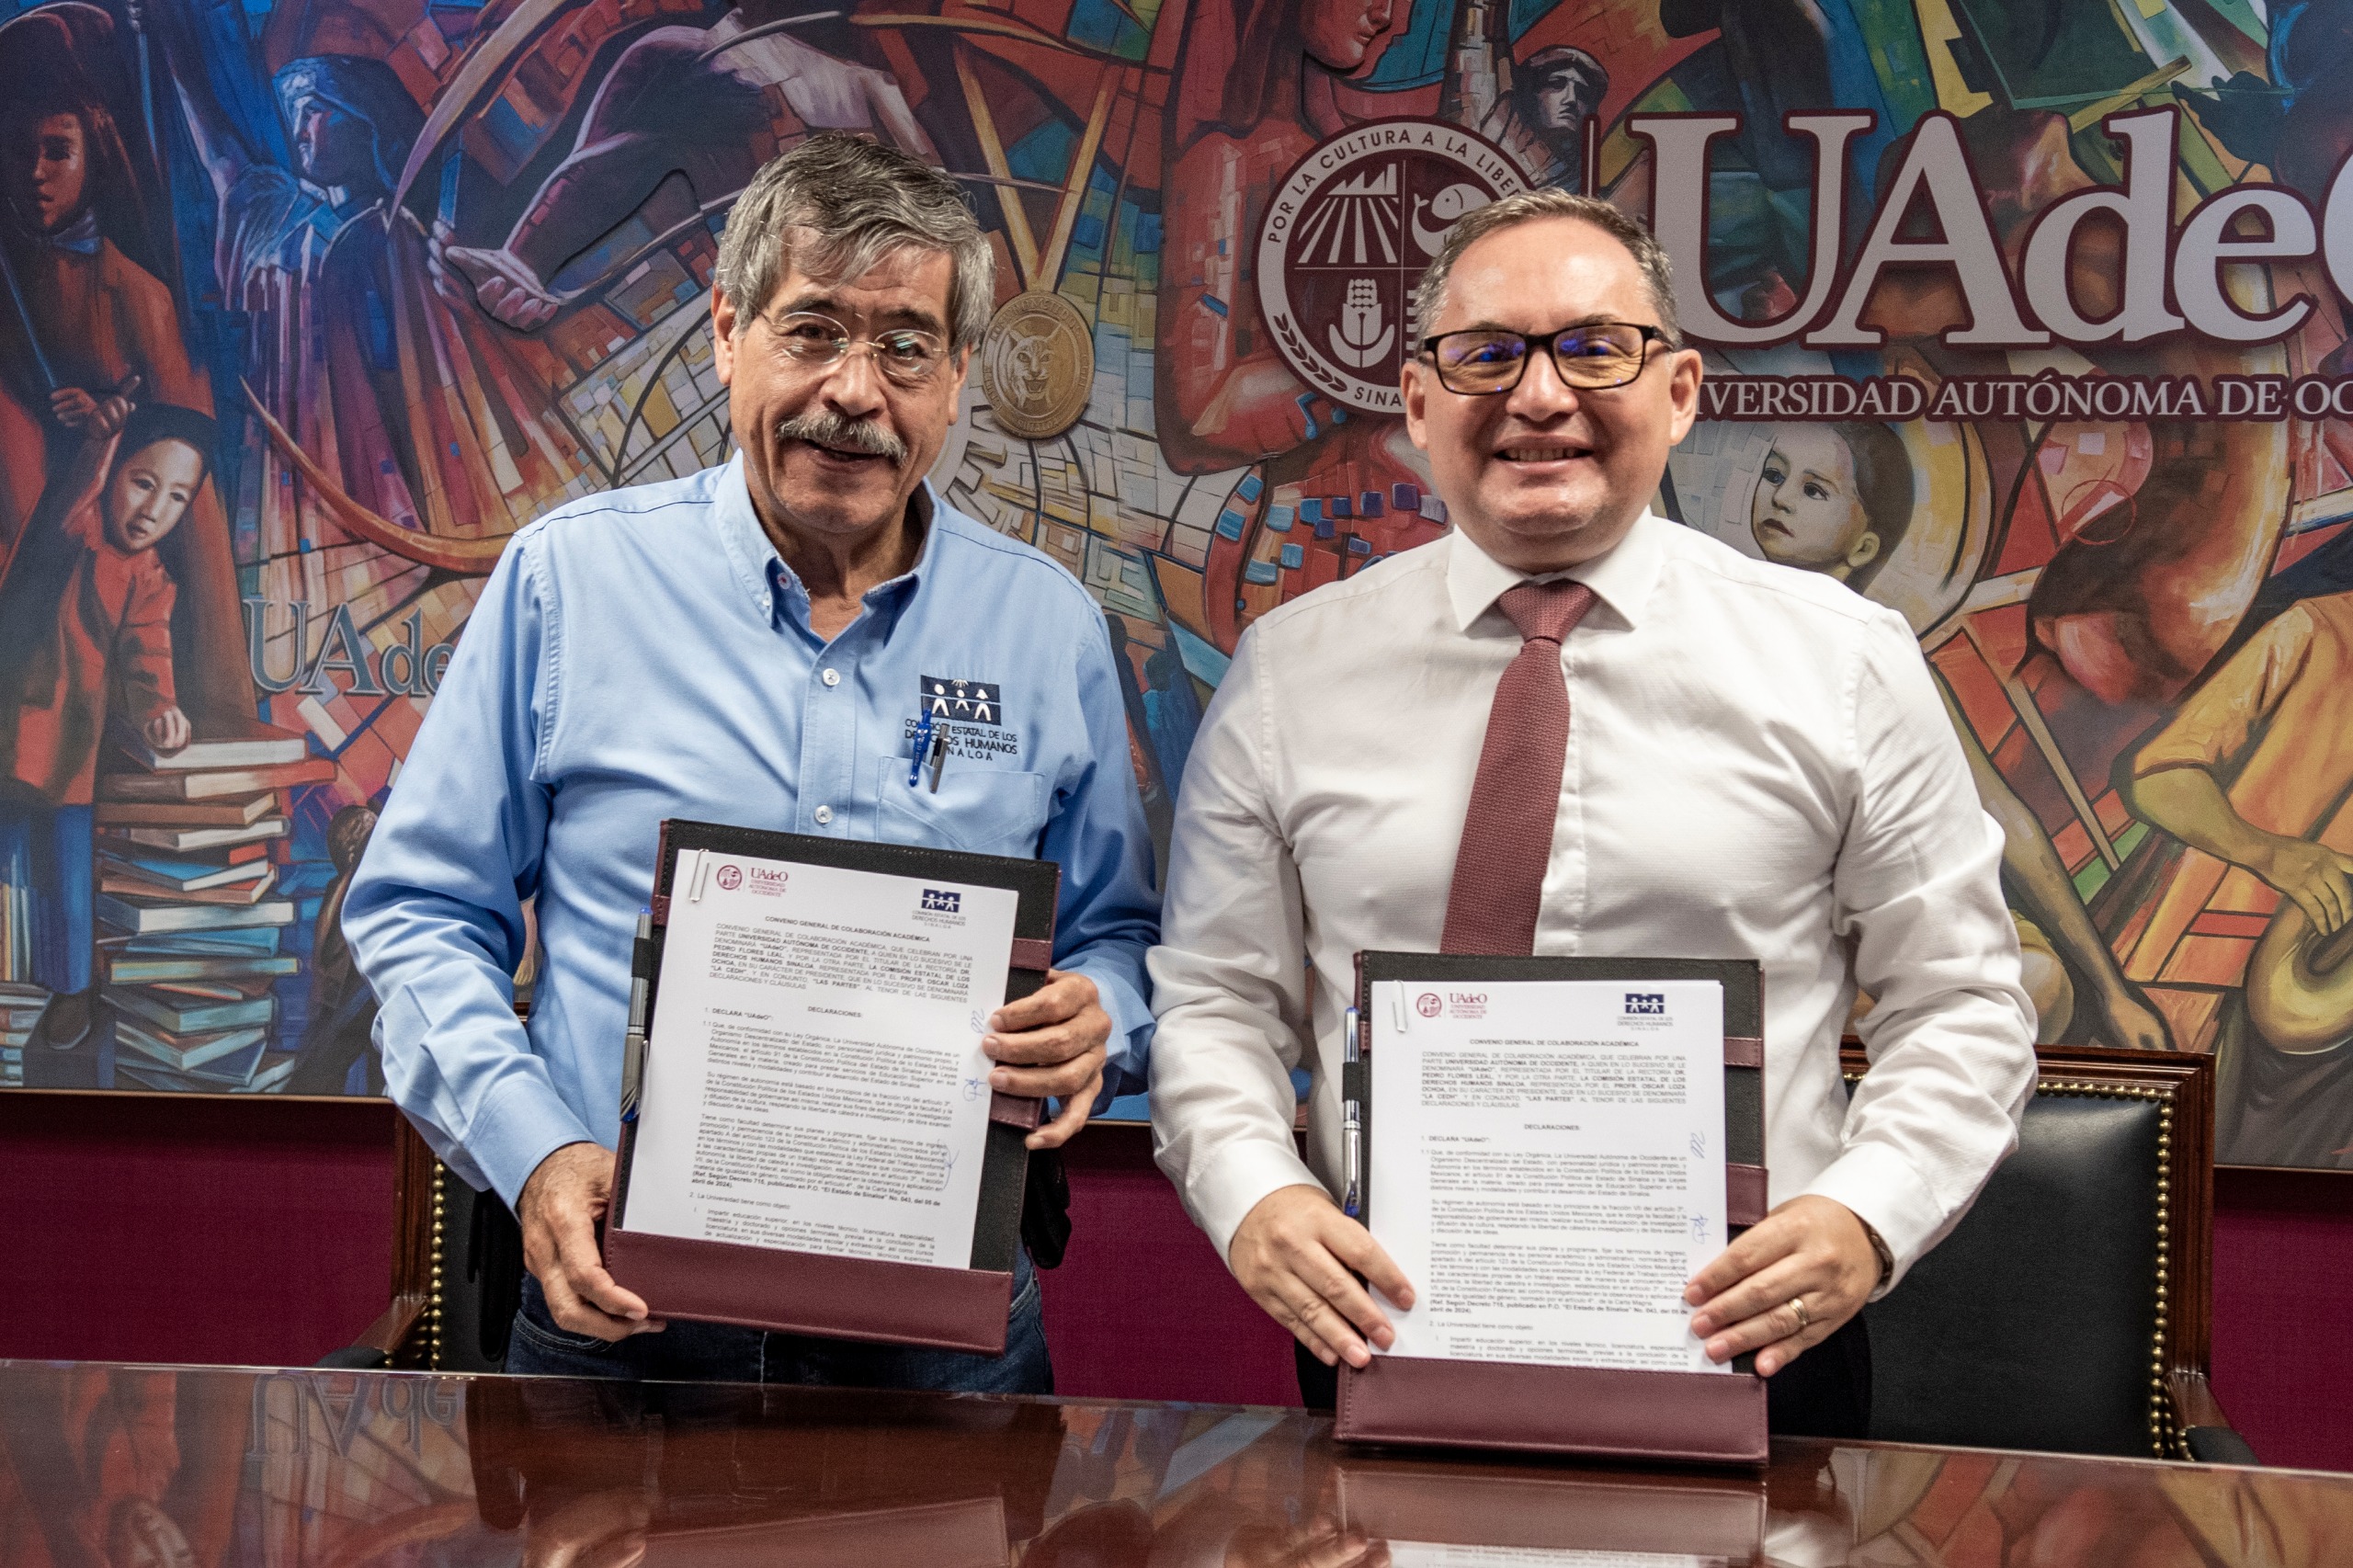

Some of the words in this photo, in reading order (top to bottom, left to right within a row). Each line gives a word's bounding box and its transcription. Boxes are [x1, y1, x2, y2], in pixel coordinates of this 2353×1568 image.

[1267, 200, 1295, 244] POR
[1291, 173, 1316, 196] LA
[1319, 129, 1412, 169] CULTURA
[1421, 131, 1435, 146] A
[1445, 136, 1468, 158] LA
[1629, 108, 2353, 346] UAde
[1354, 386, 1403, 406] SINA
[1699, 381, 1923, 416] VERSIDAD
[1931, 374, 2207, 416] AUTÓNOMA
[2217, 381, 2283, 416] DE
[243, 597, 457, 698] UAde
[951, 725, 986, 738] ESTATAL
[988, 730, 1000, 739] DE
[1003, 732, 1017, 743] LOS
[965, 737, 1017, 755] HUMANOS
[750, 867, 789, 881] UAdeO
[764, 915, 798, 926] CONVENIO
[799, 920, 828, 929] GENERAL
[840, 925, 892, 937] COLABORACIÓN
[1449, 993, 1487, 1003] UAdeO
[711, 1007, 743, 1017] DECLARA
